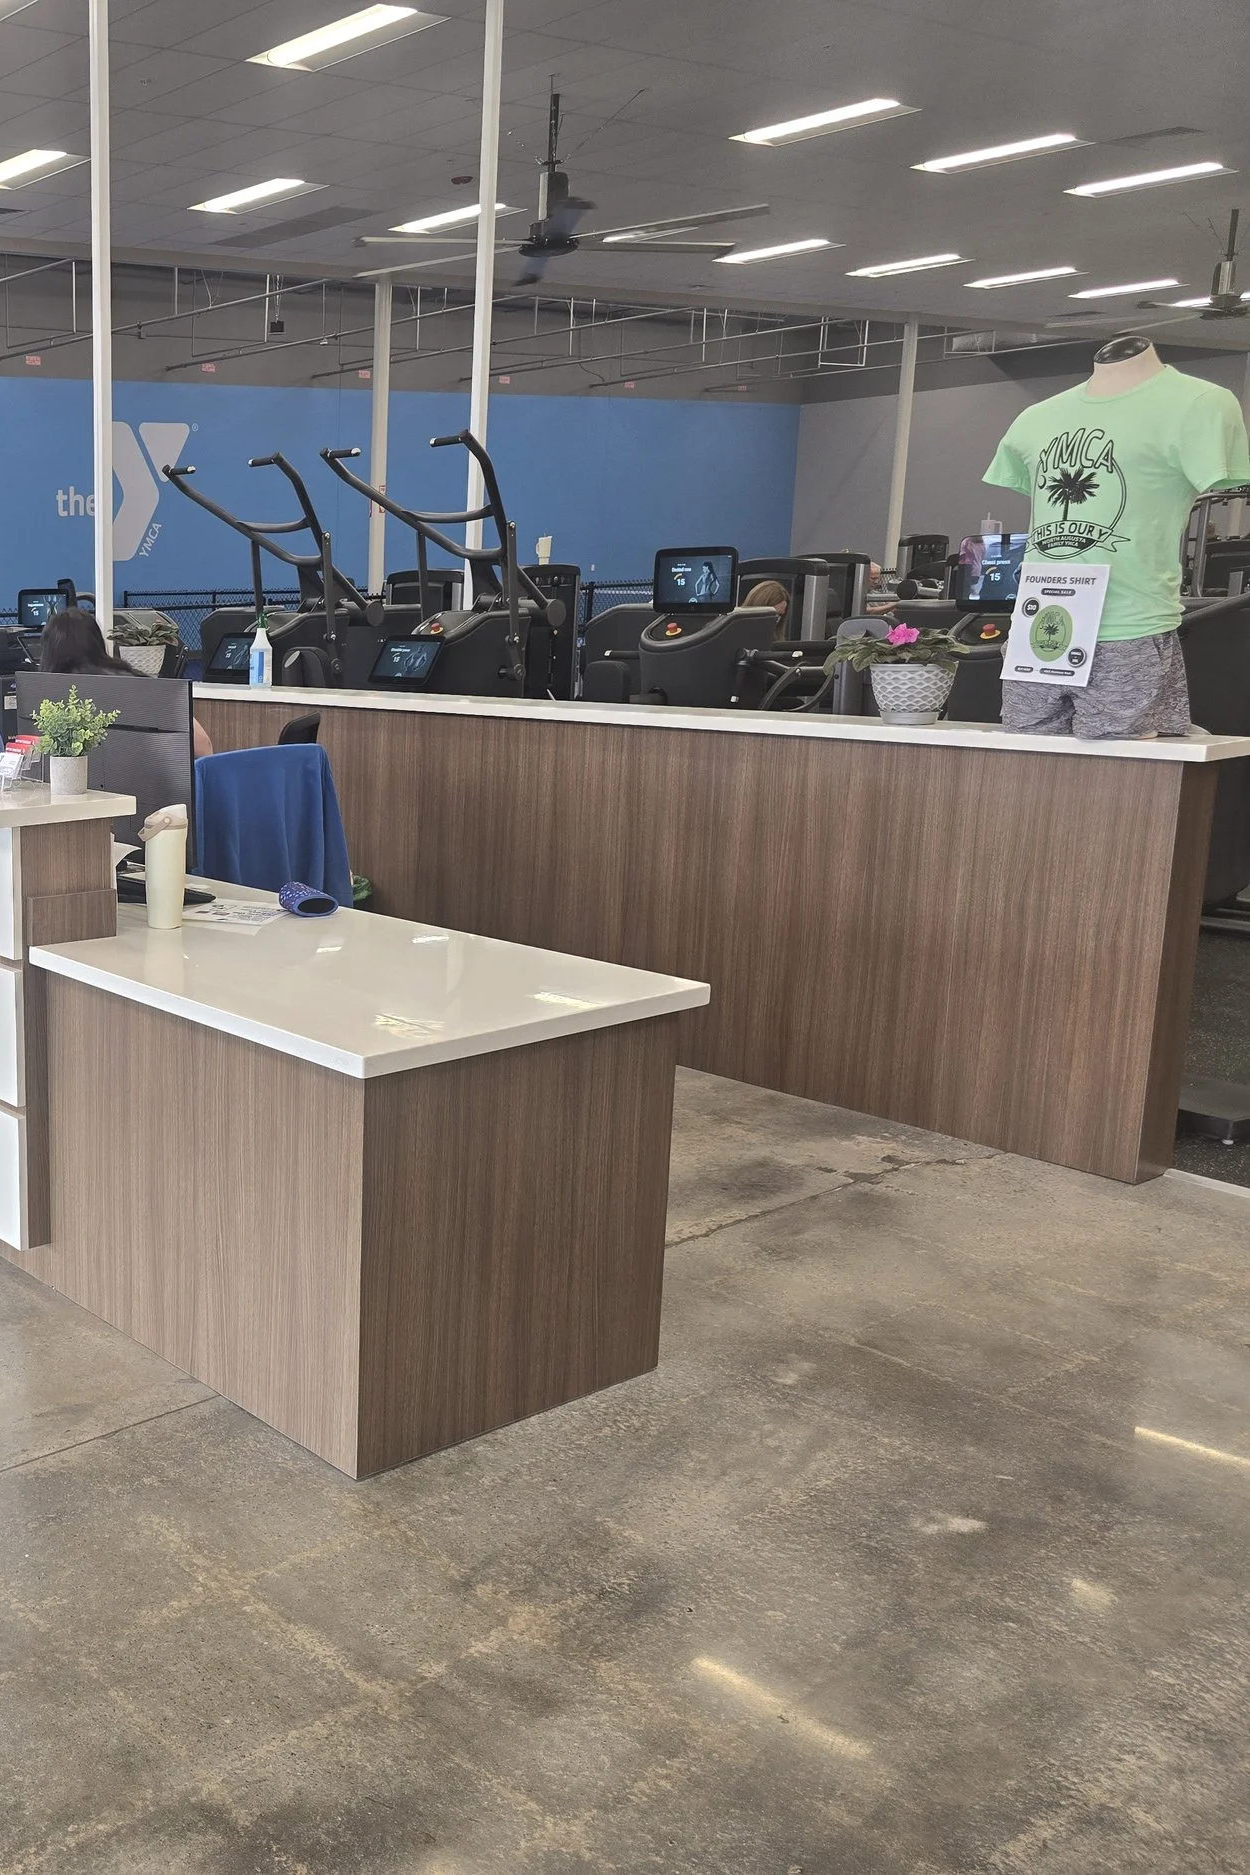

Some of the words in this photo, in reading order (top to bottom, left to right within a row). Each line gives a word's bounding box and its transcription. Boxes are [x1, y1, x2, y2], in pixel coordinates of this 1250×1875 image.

[1039, 428, 1115, 474] YMCA
[139, 522, 162, 557] YMCA
[1054, 522, 1065, 535] IS
[1068, 522, 1095, 538] OUR
[1097, 528, 1108, 540] Y
[990, 573, 1001, 581] 15
[1025, 575, 1068, 585] FOUNDERS
[1069, 577, 1097, 586] SHIRT
